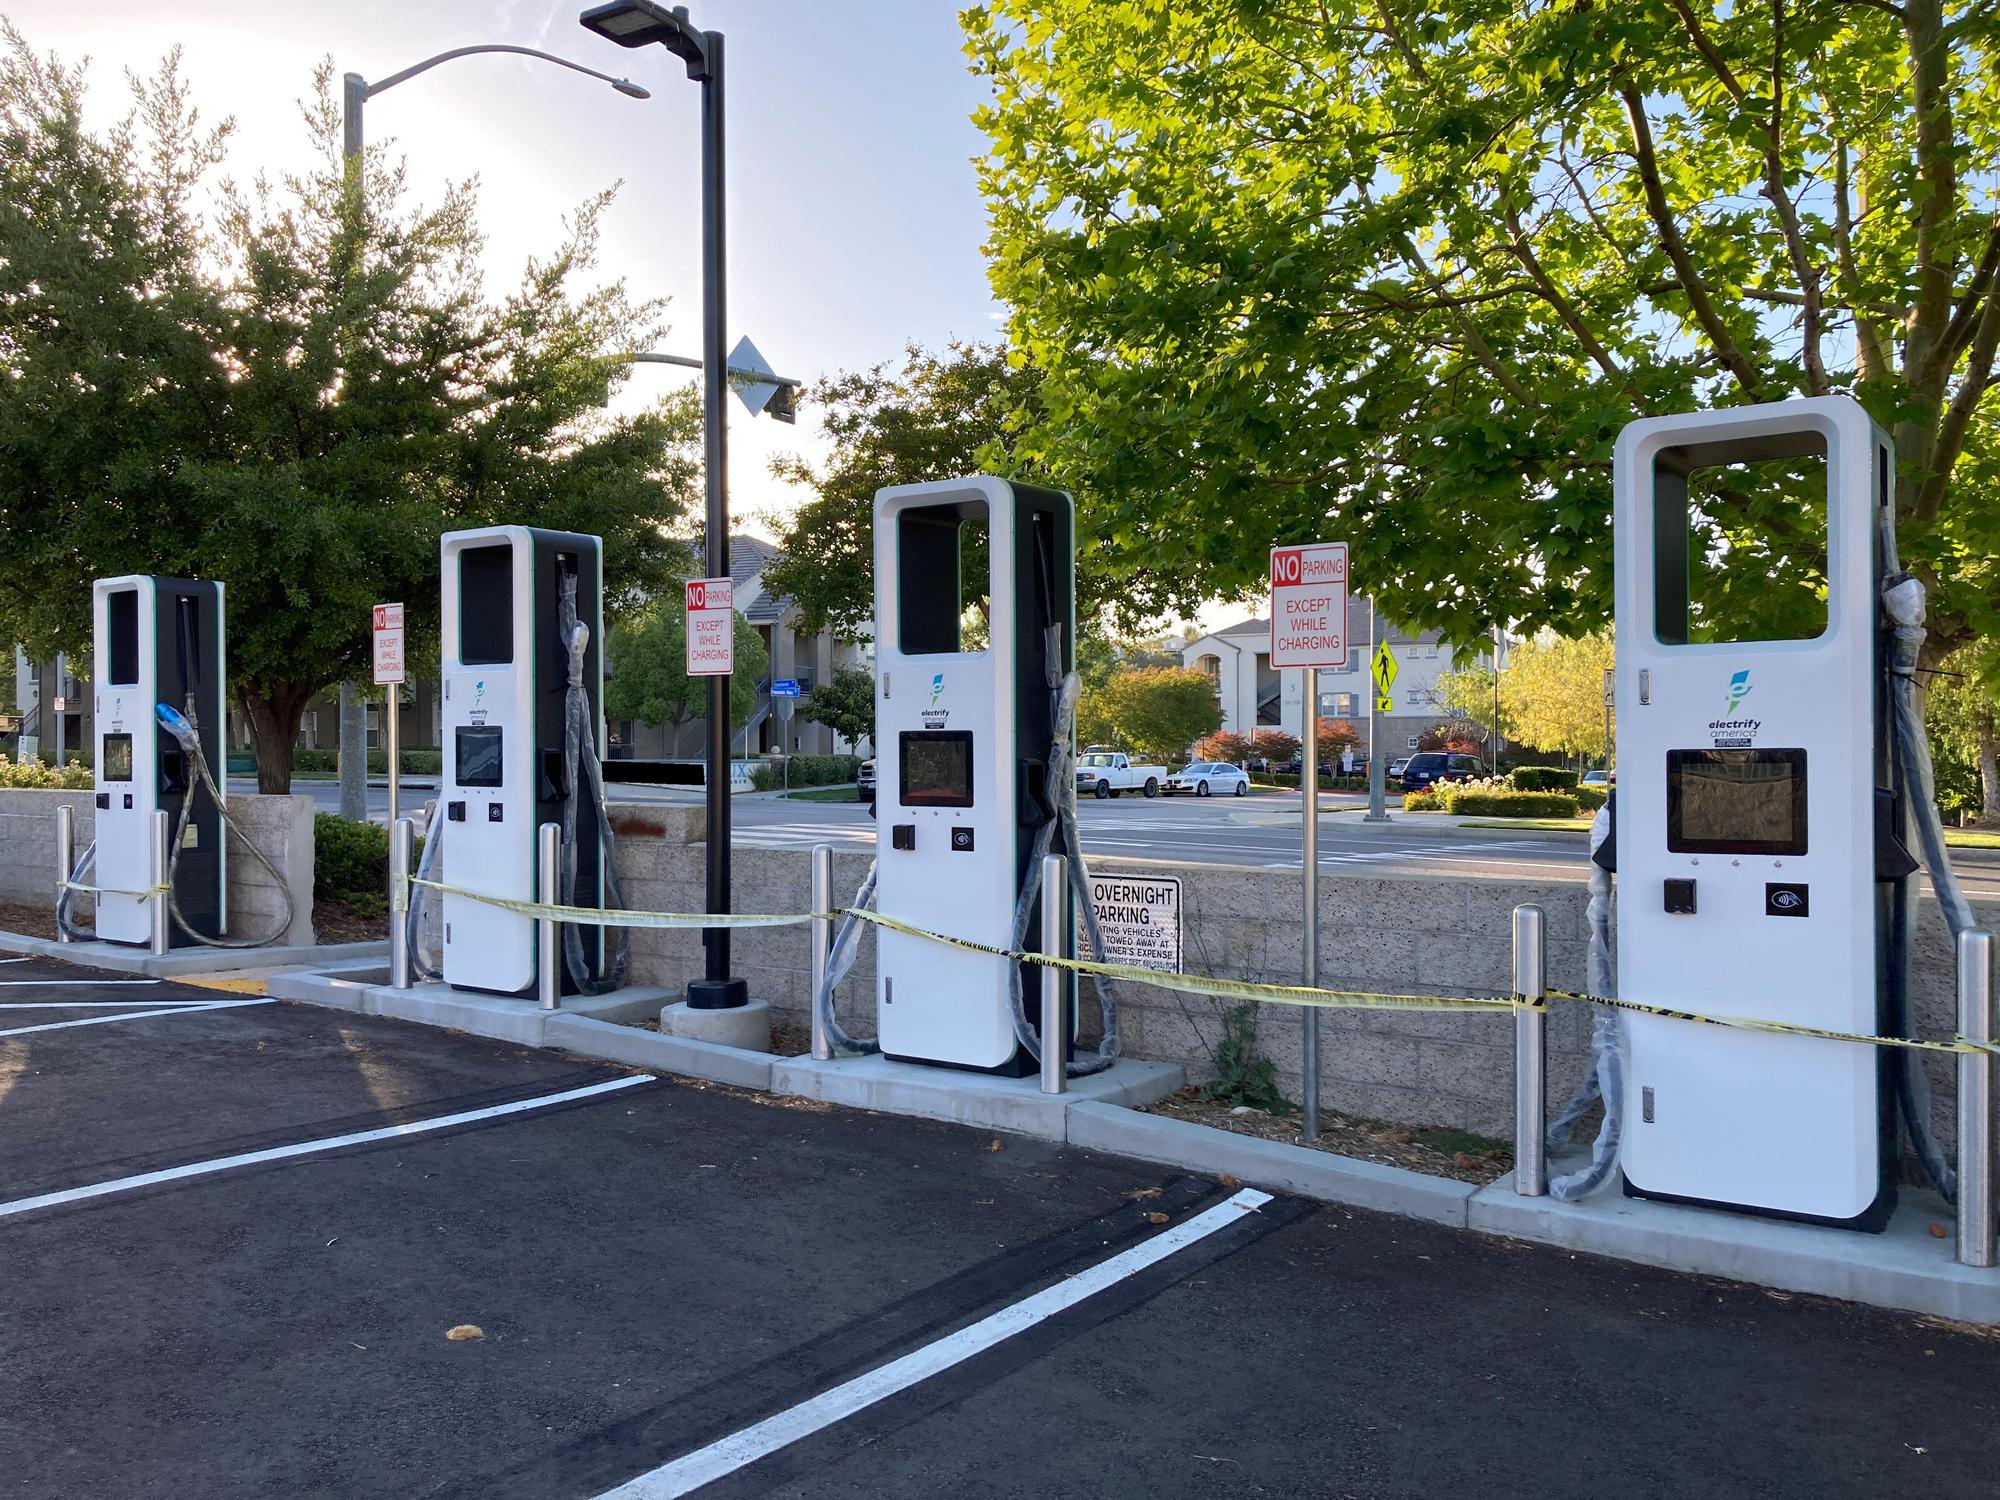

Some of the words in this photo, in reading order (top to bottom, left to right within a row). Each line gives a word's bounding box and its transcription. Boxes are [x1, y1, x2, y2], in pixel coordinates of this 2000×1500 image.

[1274, 555, 1299, 582] NO
[1302, 558, 1343, 576] PARKING
[688, 586, 704, 607] NO
[706, 590, 731, 602] PARKING
[1286, 598, 1332, 613] EXCEPT
[375, 610, 385, 627] NO
[1291, 617, 1327, 632] WHILE
[696, 620, 724, 632] EXCEPT
[379, 638, 398, 648] EXCEPT
[699, 635, 721, 646] WHILE
[1278, 635, 1340, 651] CHARGING
[691, 649, 729, 661] CHARGING
[921, 709, 950, 718] electrify
[1708, 719, 1761, 729] electrify
[1710, 729, 1757, 738] america
[1094, 884, 1173, 905] OVERNIGHT
[1122, 928, 1161, 938] VEHICLES
[1106, 935, 1133, 946] TOWED
[1136, 938, 1156, 947] AWAY
[1160, 940, 1169, 949] AT
